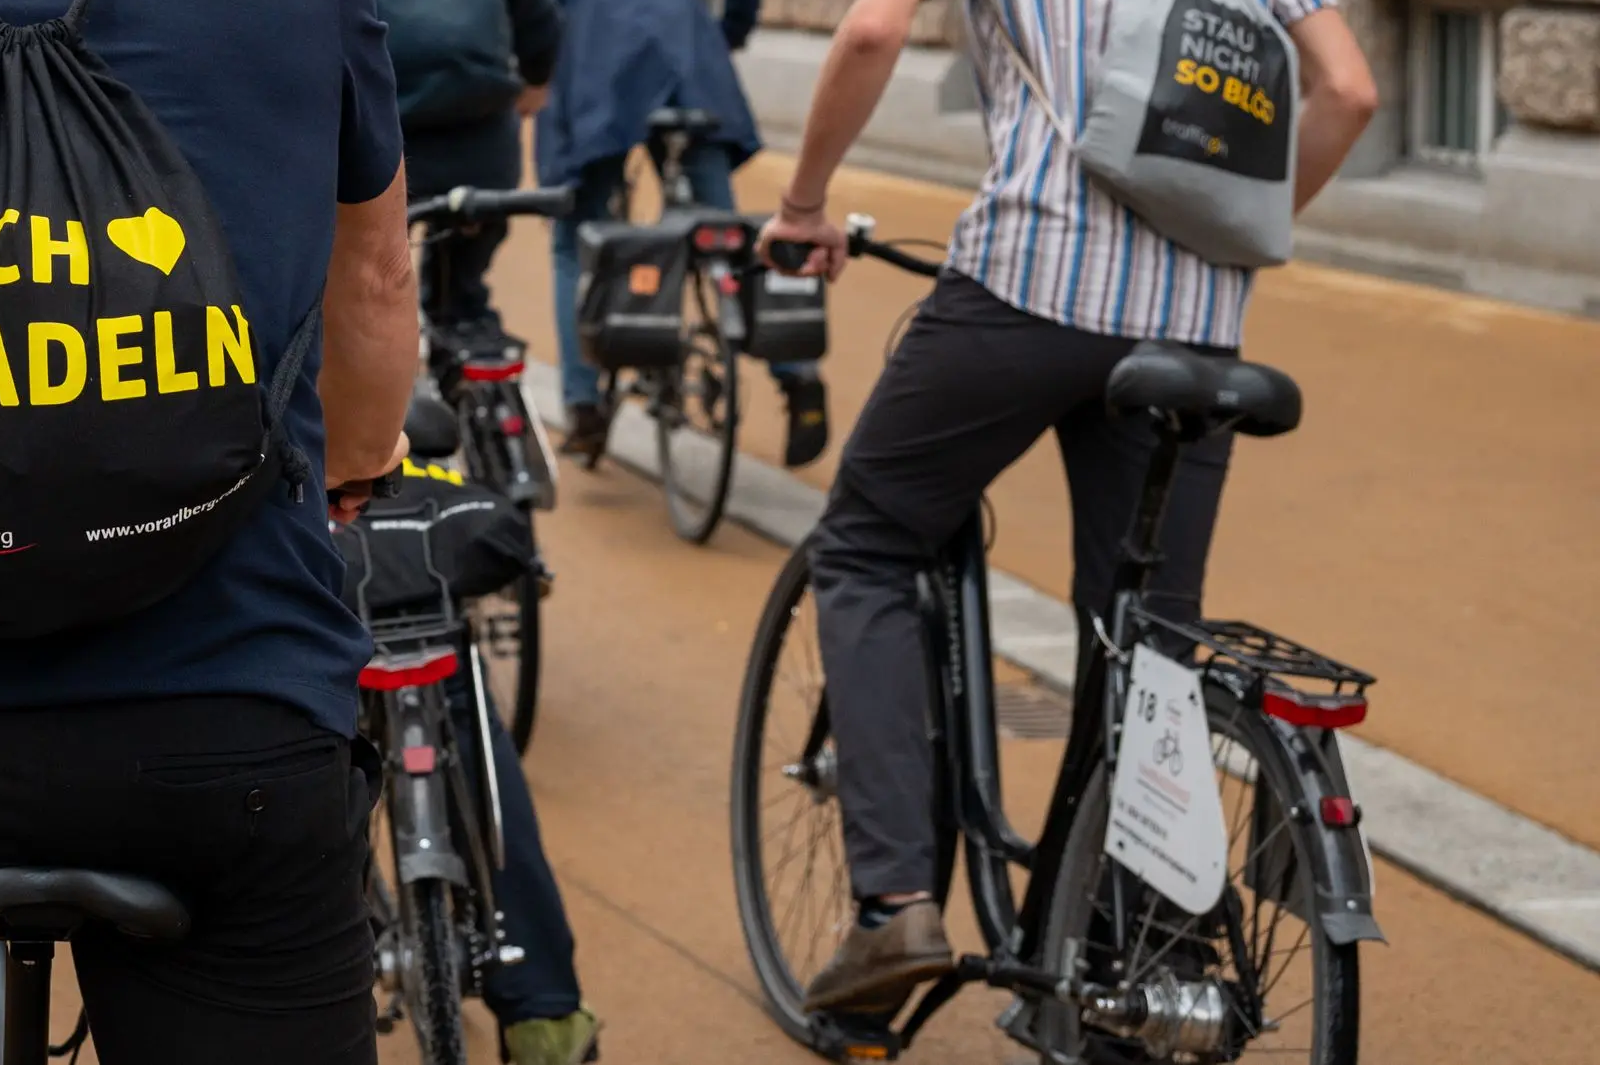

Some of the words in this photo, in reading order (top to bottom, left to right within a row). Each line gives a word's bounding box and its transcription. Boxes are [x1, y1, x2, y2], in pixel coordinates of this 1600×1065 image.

[1181, 8, 1256, 53] STAU
[1173, 58, 1220, 93] SO
[1137, 689, 1157, 724] 18
